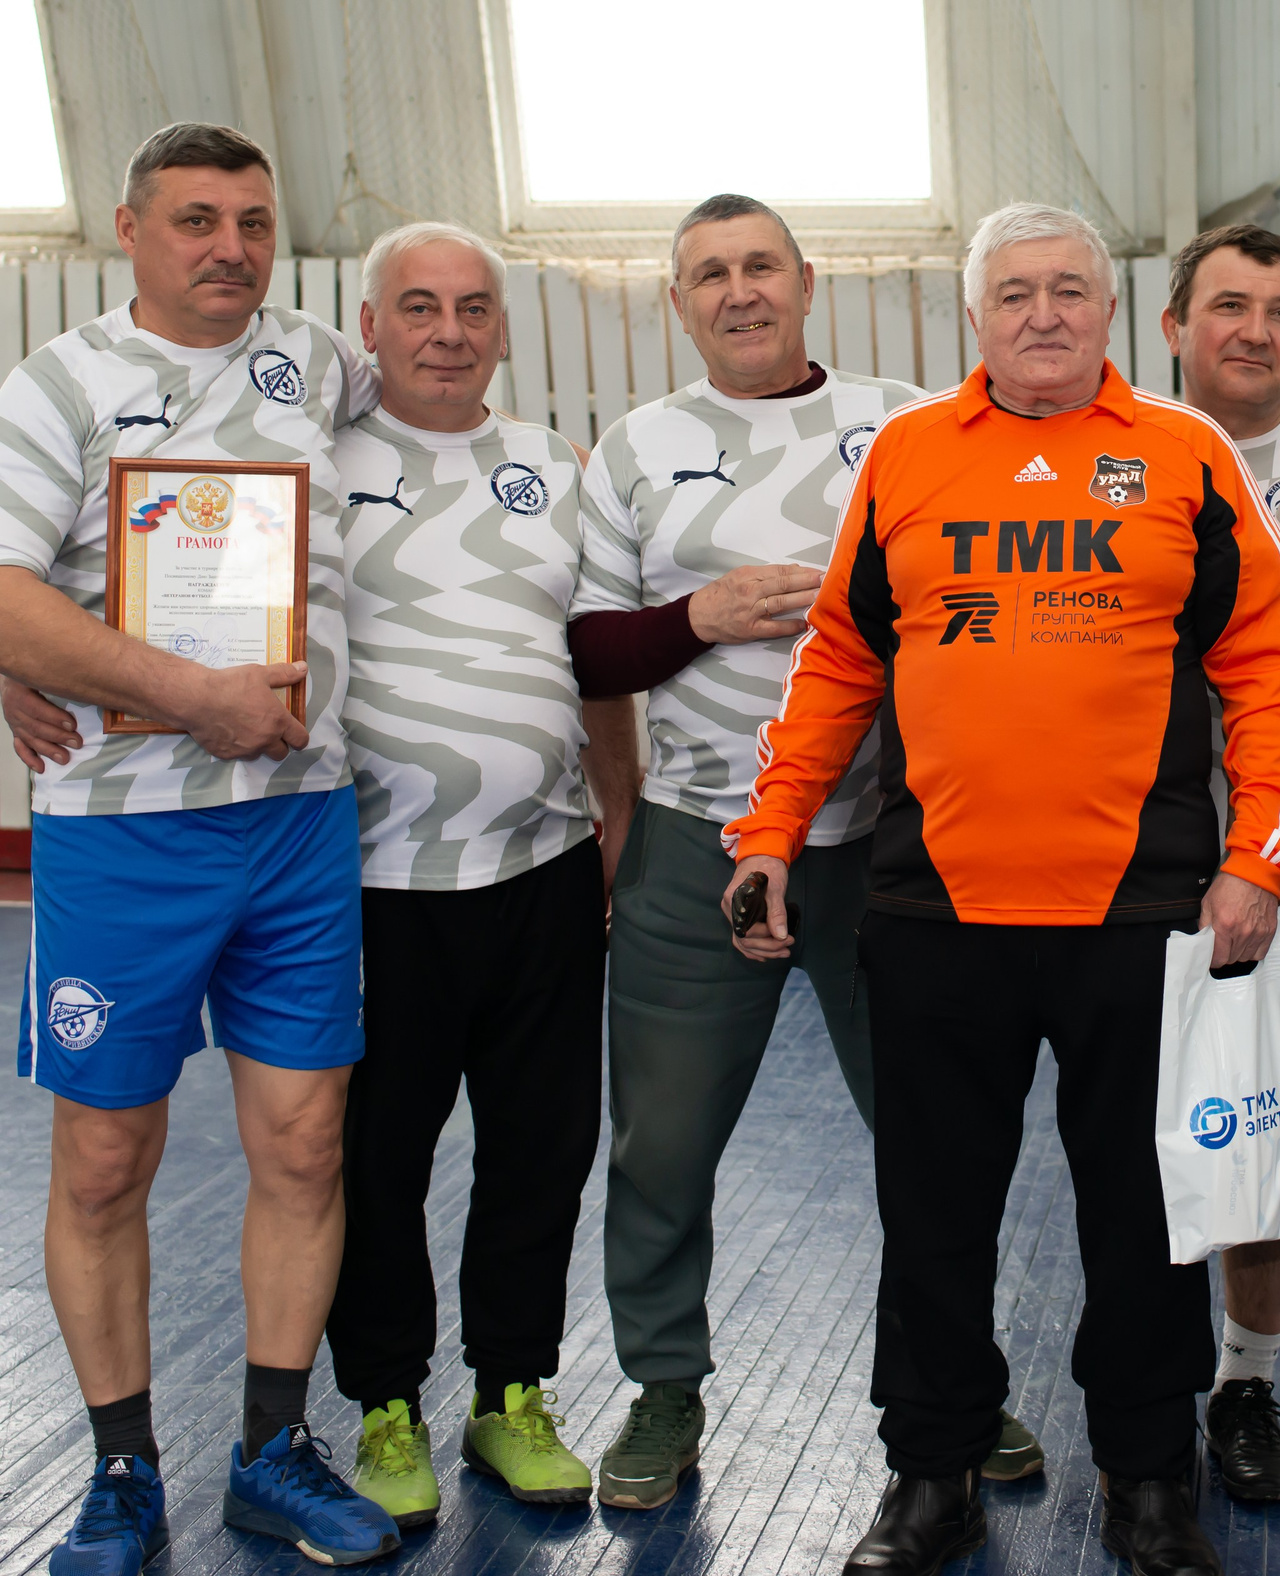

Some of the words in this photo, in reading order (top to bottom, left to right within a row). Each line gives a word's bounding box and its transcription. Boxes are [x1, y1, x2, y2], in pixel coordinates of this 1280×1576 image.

[1014, 470, 1058, 482] adidas
[1098, 471, 1141, 486] УРАЛ
[177, 536, 240, 549] ГРАМОТА
[941, 519, 1124, 574] ТМК
[1033, 590, 1124, 612] РЕНОВА
[1032, 613, 1096, 625] ГРУППА
[1030, 630, 1124, 646] КОМПАНИЙ
[51, 979, 82, 993] СТАНИЦА
[62, 1020, 106, 1048] КРИВЯНСКАЯ
[1242, 1087, 1279, 1116] ТМХ
